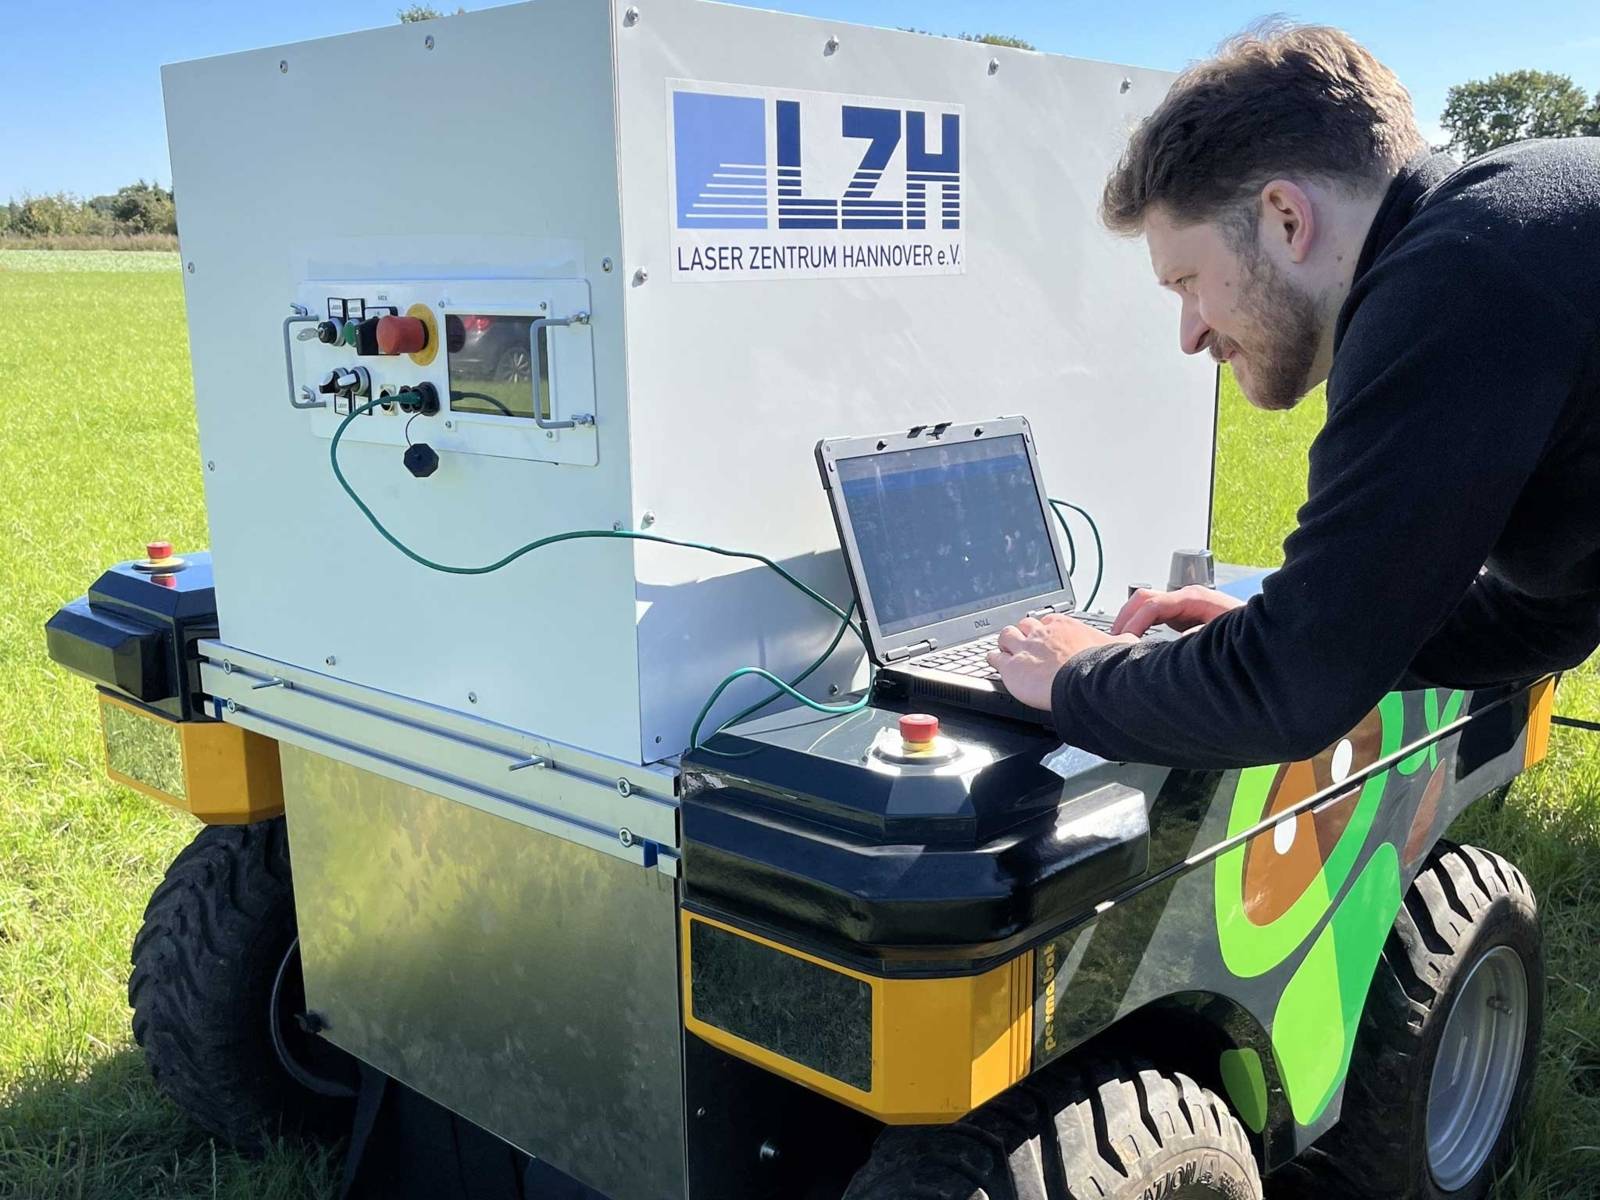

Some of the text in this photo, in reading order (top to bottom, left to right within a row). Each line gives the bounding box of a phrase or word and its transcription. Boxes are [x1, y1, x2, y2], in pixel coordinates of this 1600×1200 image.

[776, 99, 960, 230] LZH
[677, 244, 961, 271] LASER ZENTRUM HANNOVER e.V.
